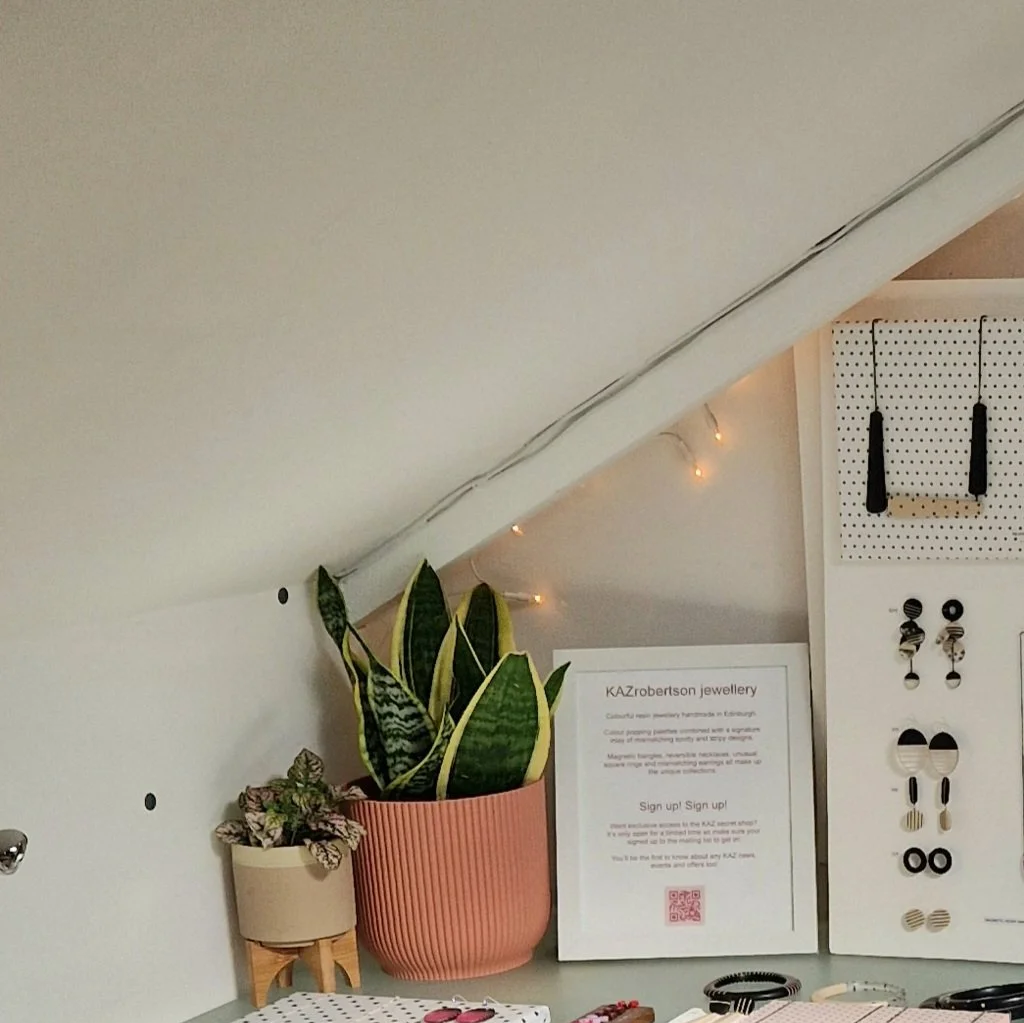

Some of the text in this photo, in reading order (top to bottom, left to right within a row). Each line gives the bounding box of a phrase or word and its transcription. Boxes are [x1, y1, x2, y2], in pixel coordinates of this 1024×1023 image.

[606, 684, 757, 698] KAZrobertson jewellery
[640, 800, 727, 813] Sign up! Sign up!
